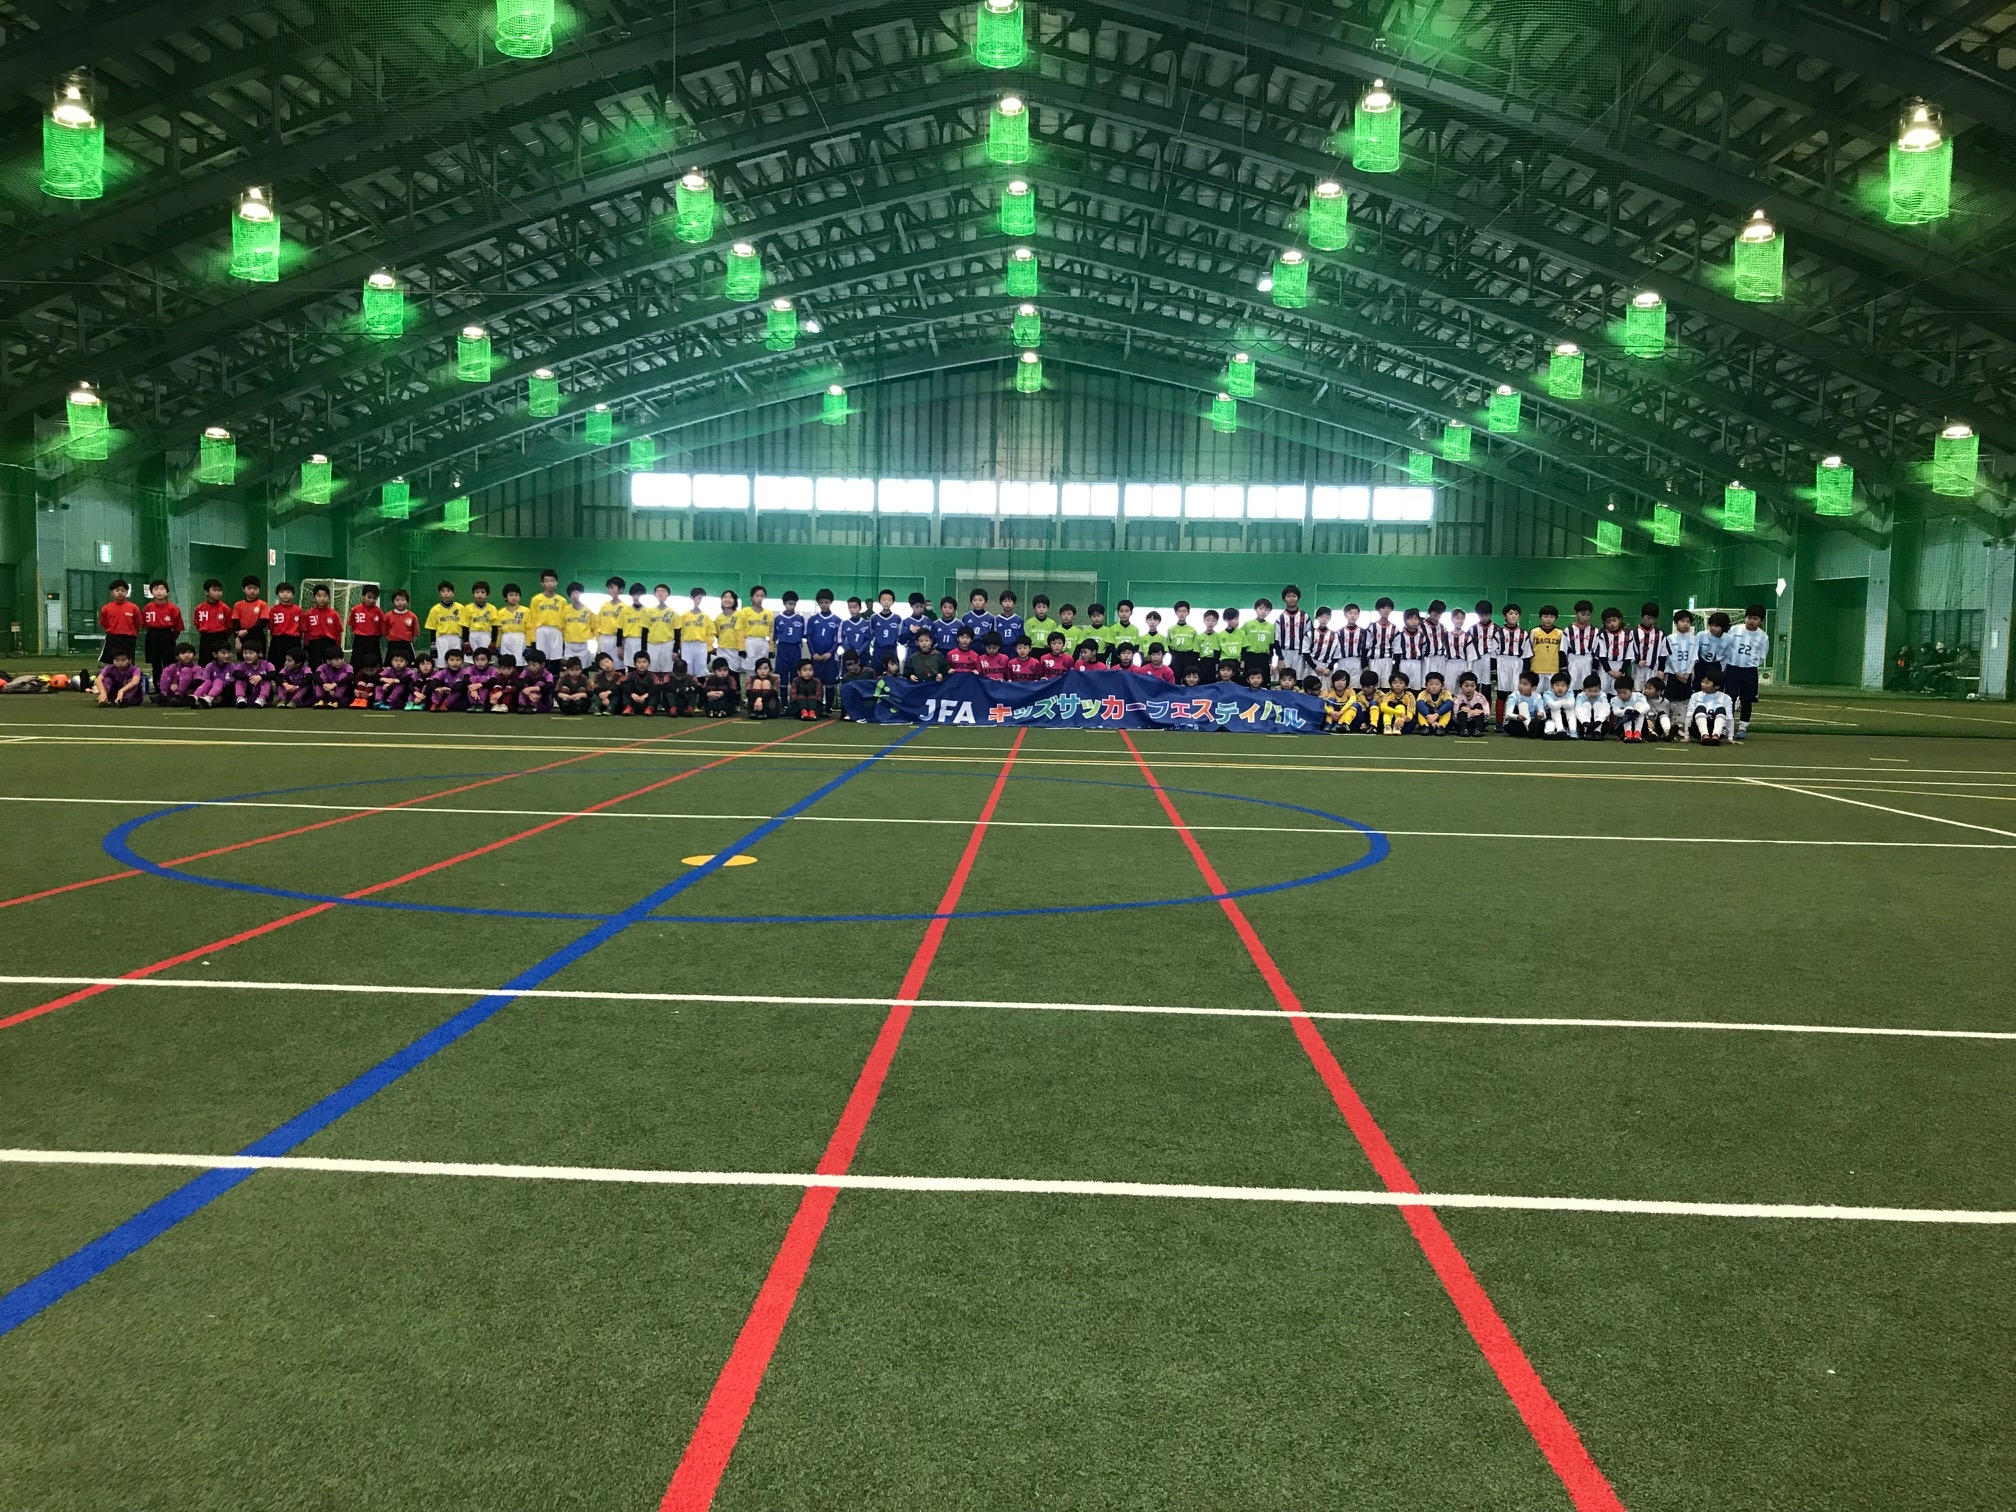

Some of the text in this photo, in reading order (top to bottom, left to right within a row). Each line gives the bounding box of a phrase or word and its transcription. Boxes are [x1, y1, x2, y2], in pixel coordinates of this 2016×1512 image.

[145, 611, 156, 622] 37
[199, 611, 209, 621] 34
[273, 613, 285, 624] 33
[355, 612, 366, 623] 32
[787, 627, 793, 636] 3
[821, 628, 826, 636] 1
[883, 629, 889, 638] 9
[1004, 629, 1012, 637] 13
[854, 633, 860, 642] 7
[942, 635, 950, 643] 11
[1036, 633, 1045, 641] 18
[1737, 643, 1752, 656] 22
[1677, 650, 1689, 662] 33
[919, 693, 1306, 729] JFA キッズサッカーフェスティバル
